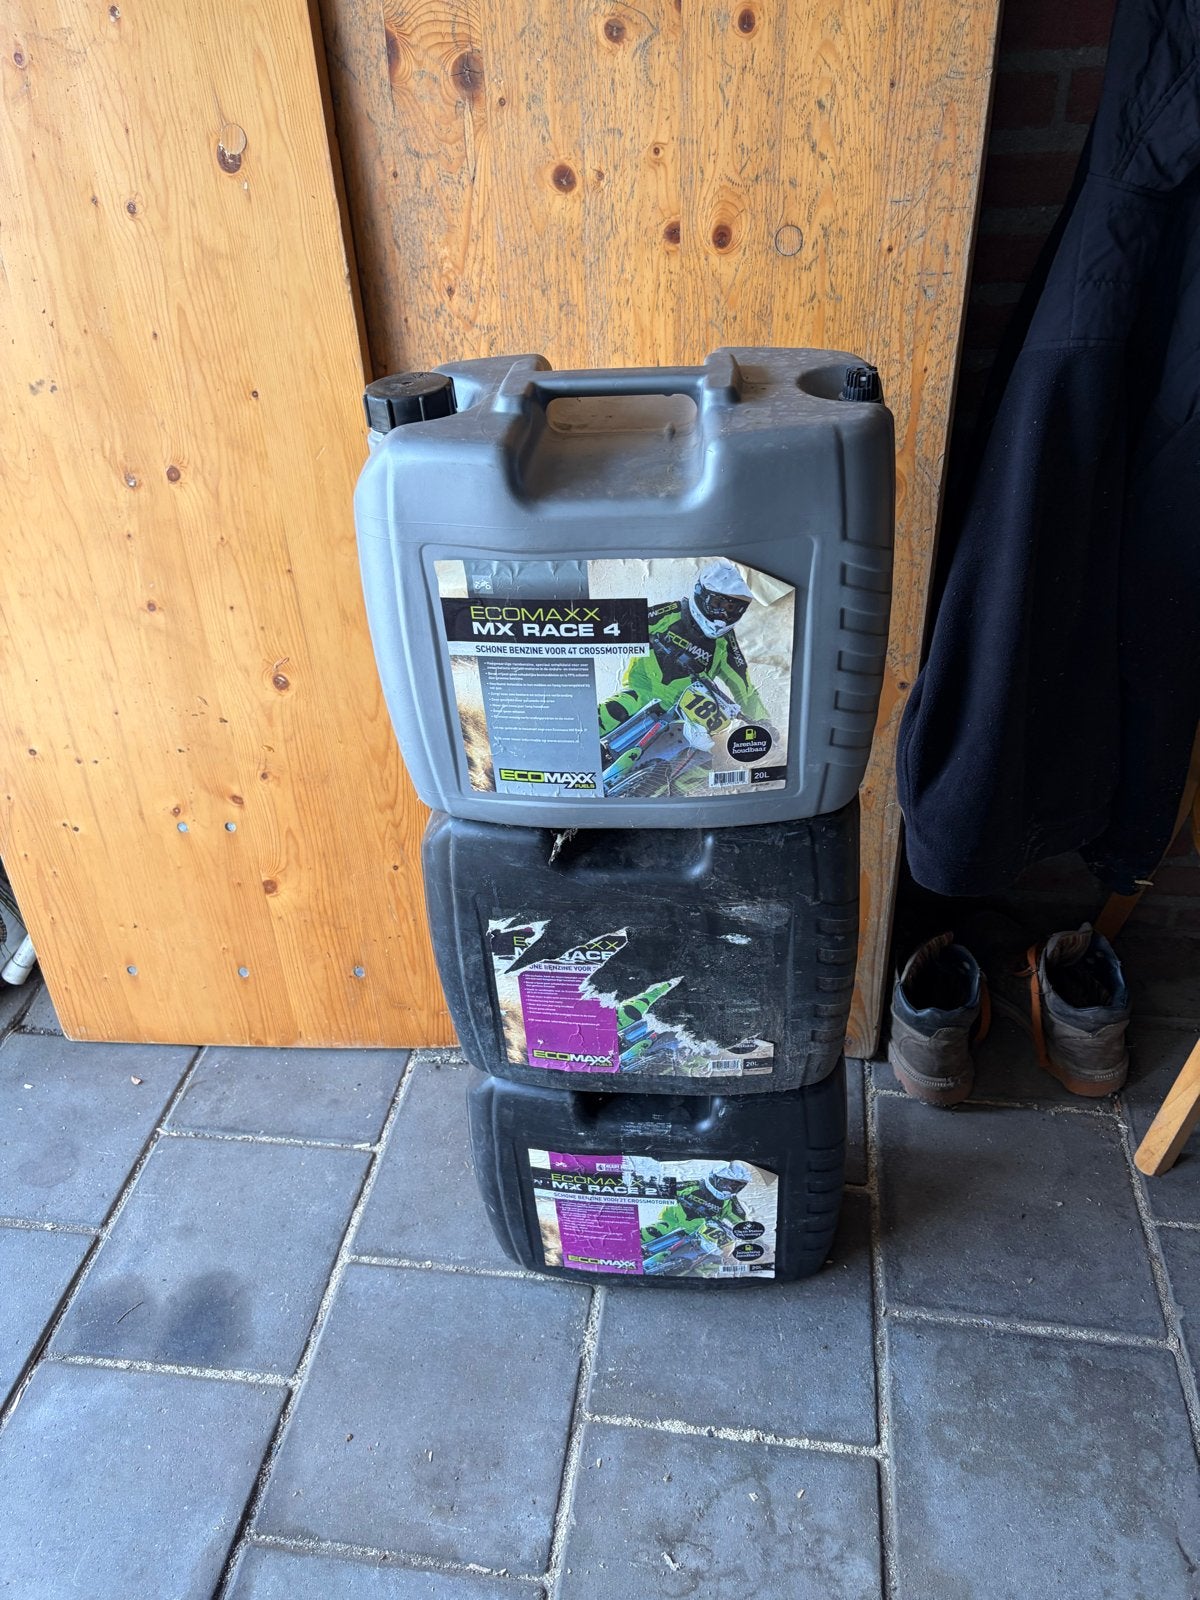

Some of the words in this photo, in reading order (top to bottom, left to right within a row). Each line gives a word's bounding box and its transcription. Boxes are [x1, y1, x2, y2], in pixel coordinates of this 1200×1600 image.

[470, 606, 601, 622] ECOMAXX
[472, 621, 514, 637] MX
[522, 623, 595, 637] RACE
[603, 622, 621, 637] 4
[475, 644, 508, 654] SCHONE
[509, 646, 544, 655] BENZINE
[544, 646, 567, 655] VOOR
[567, 646, 577, 655] 4T
[578, 646, 645, 655] CROSSMOTOREN
[685, 692, 727, 733] 185
[732, 747, 767, 755] houdbaar
[500, 769, 594, 788] ECOMAXX
[533, 1050, 612, 1066] ECOMAXX
[552, 1180, 582, 1191] MX
[588, 1184, 639, 1195] RACE
[645, 1187, 657, 1195] 2
